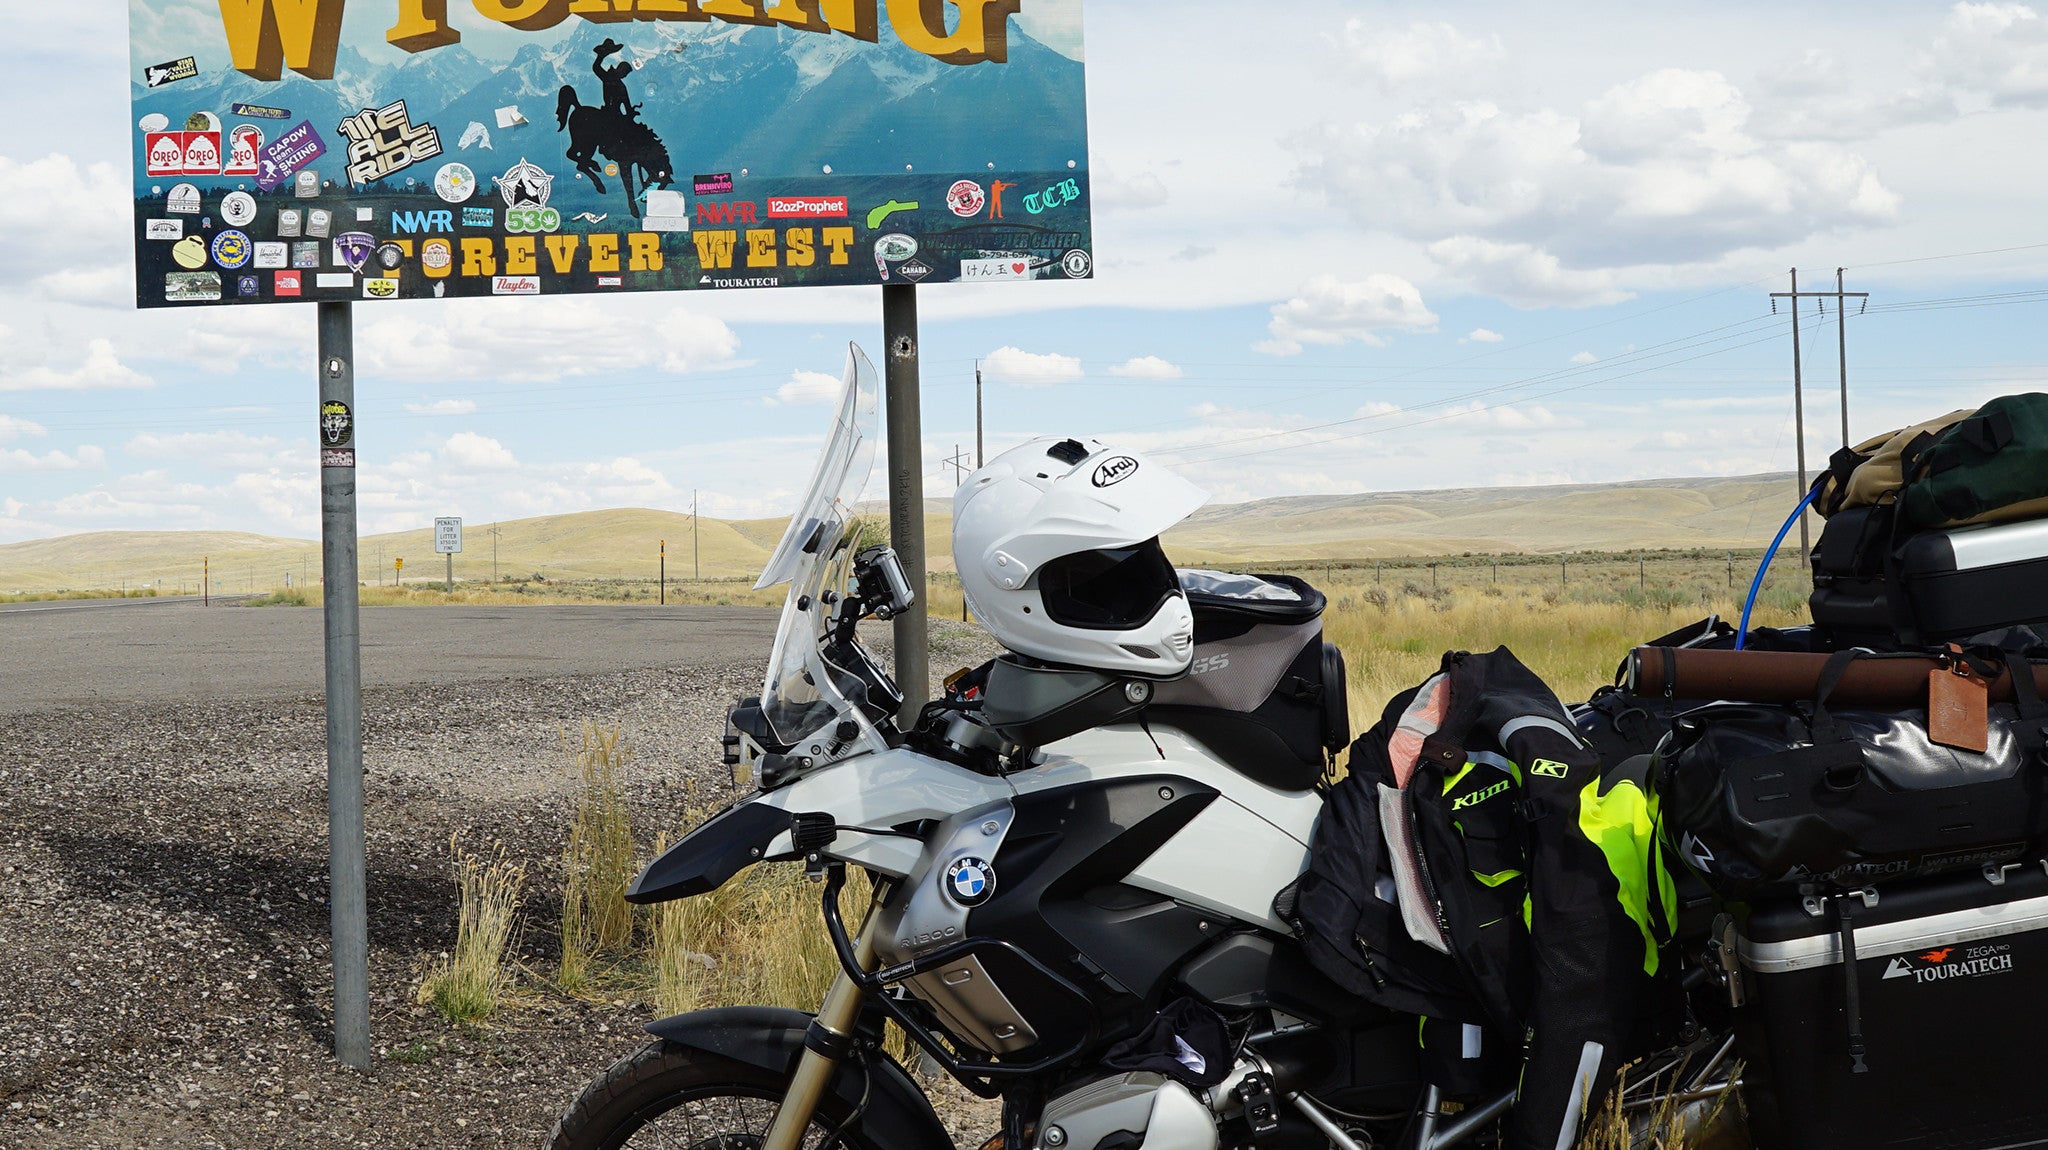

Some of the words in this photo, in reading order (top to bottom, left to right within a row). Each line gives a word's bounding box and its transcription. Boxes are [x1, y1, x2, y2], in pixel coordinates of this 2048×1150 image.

[268, 126, 307, 156] CAPOW
[351, 124, 428, 163] ALL
[153, 150, 179, 162] OREO
[188, 149, 214, 161] OREO
[273, 147, 294, 162] team
[279, 142, 318, 171] SKIING
[351, 133, 437, 184] RIDE
[1023, 178, 1080, 214] TCB
[771, 200, 844, 214] 12ozProphet
[508, 210, 557, 230] 530
[692, 226, 854, 269] WEST
[901, 266, 927, 274] CANADA
[966, 264, 1008, 277] けん玉
[497, 278, 537, 292] Naylor
[714, 277, 778, 288] TOURATECH
[1101, 456, 1134, 485] Arai
[1452, 780, 1510, 811] Klim
[949, 858, 988, 877] BMW
[1966, 946, 1996, 959] ZEGA
[1913, 955, 2012, 984] TOURATECH
